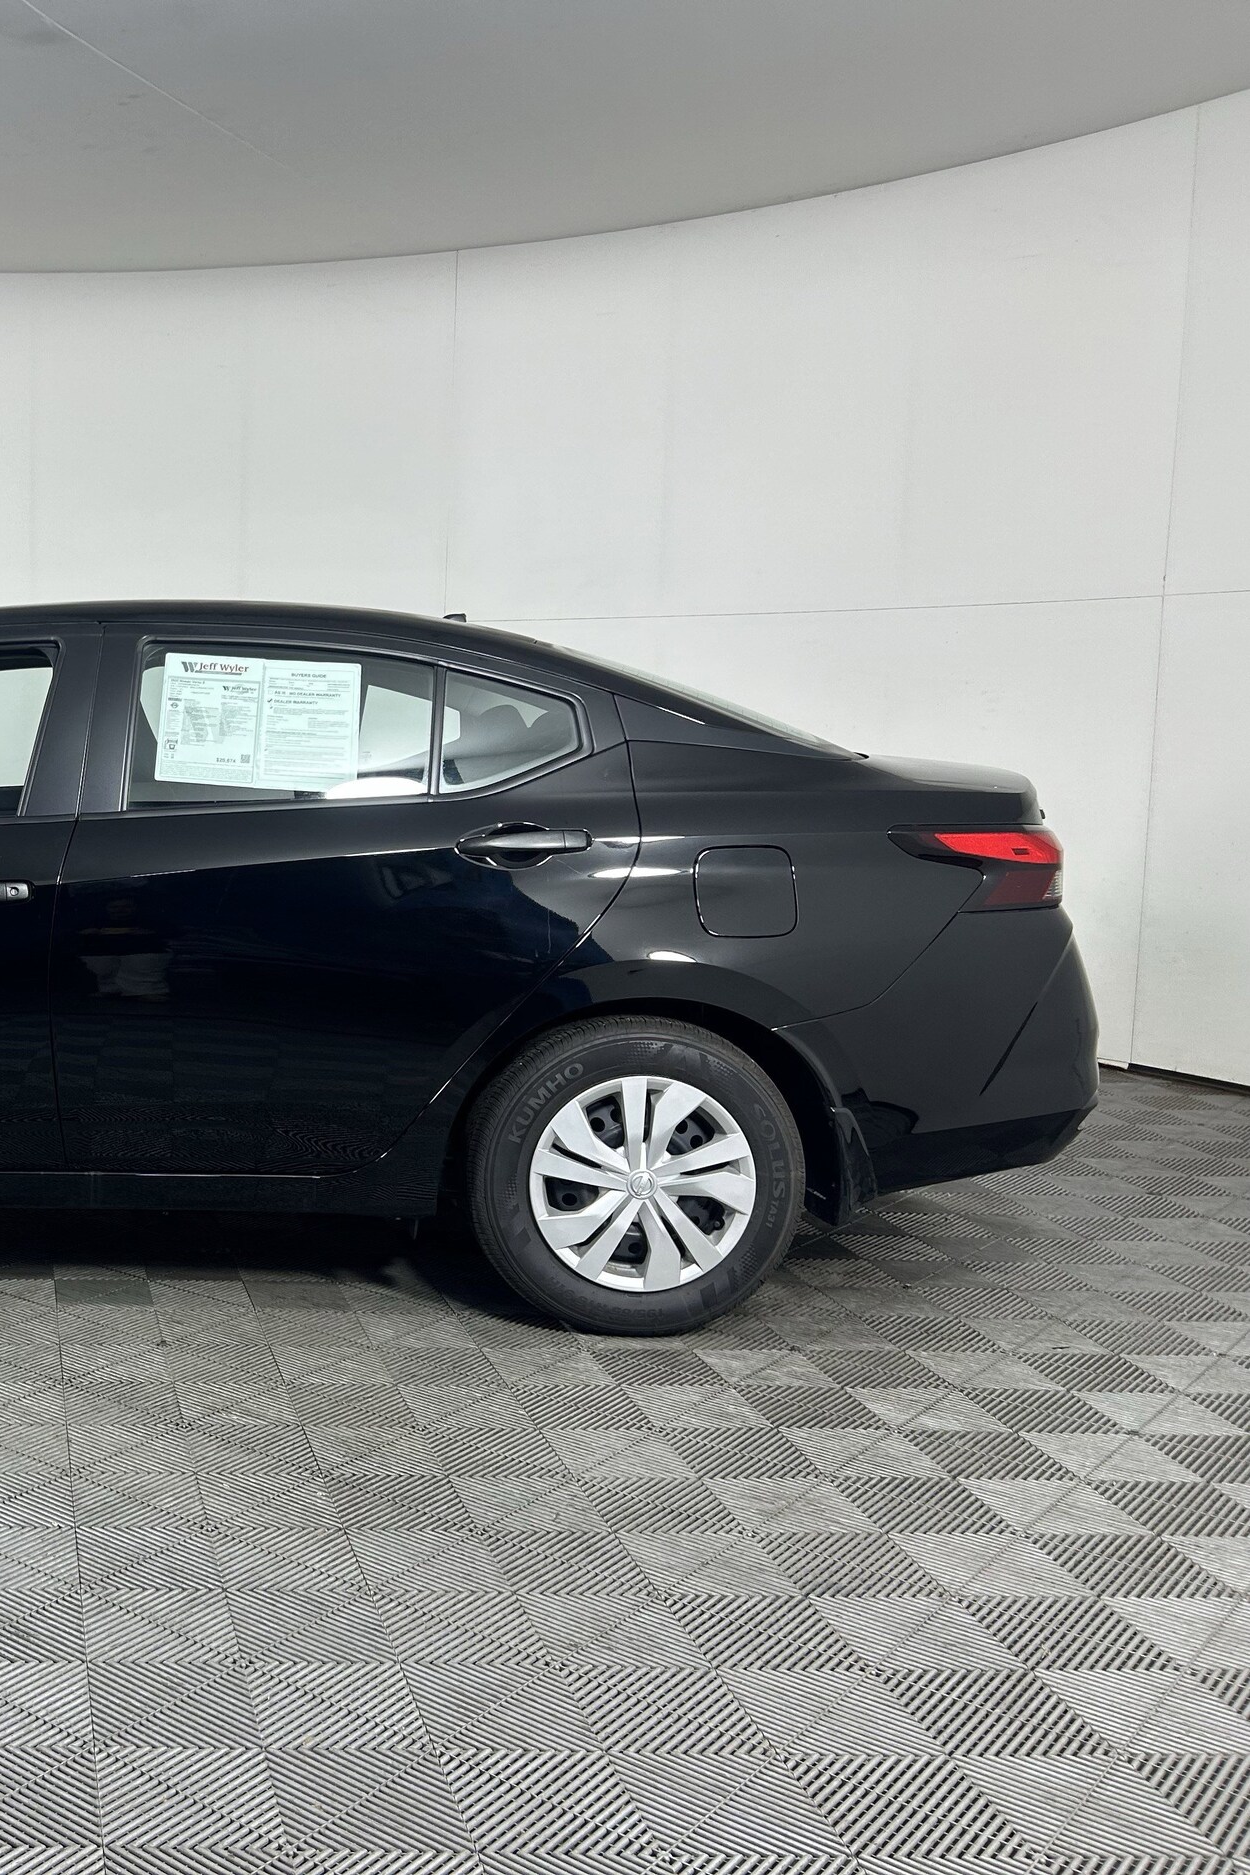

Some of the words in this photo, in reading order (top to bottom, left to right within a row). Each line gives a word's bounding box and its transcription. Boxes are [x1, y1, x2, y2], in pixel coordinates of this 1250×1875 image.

[199, 662, 218, 671] Jeff
[219, 663, 249, 673] Wyler
[507, 1062, 585, 1143] KUMHO
[752, 1102, 786, 1200] SOLUS
